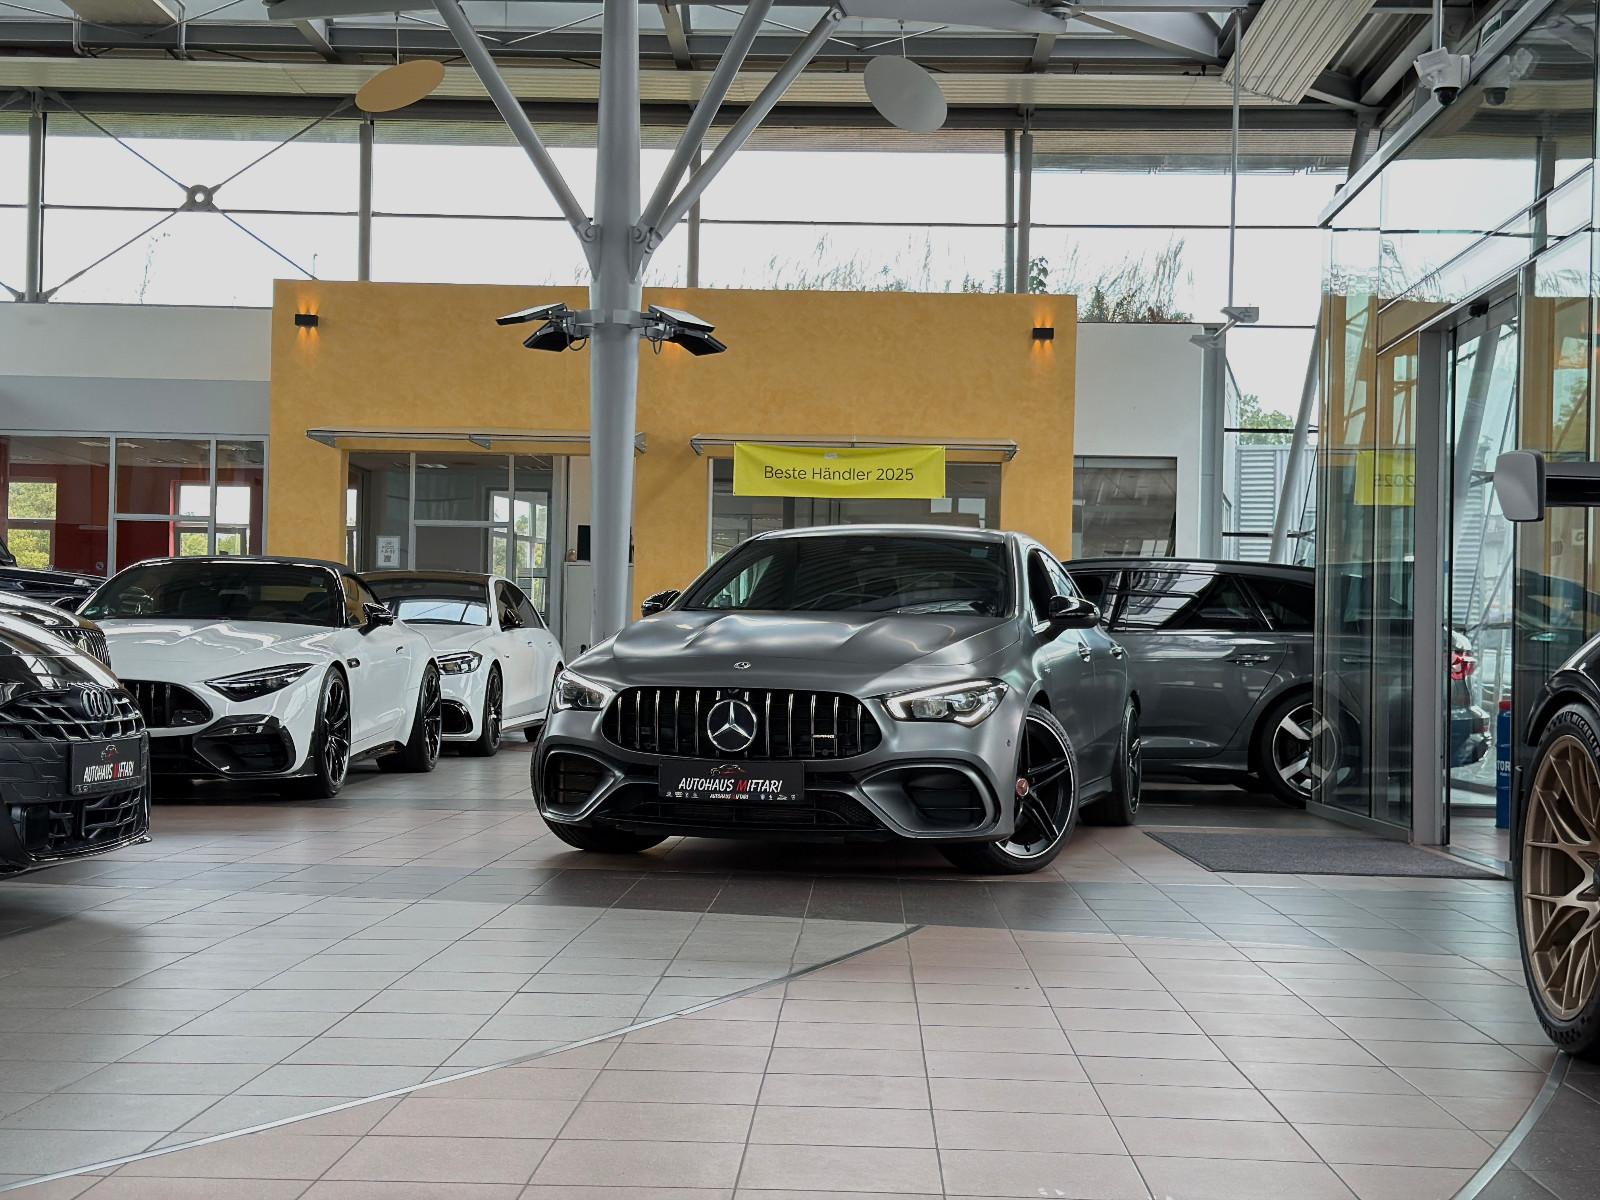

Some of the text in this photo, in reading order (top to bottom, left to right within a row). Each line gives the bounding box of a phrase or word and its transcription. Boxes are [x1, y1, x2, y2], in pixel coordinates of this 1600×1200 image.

[764, 465, 914, 481] Beste Händler 2025
[678, 777, 783, 793] AUTOHAUS MIFTARI
